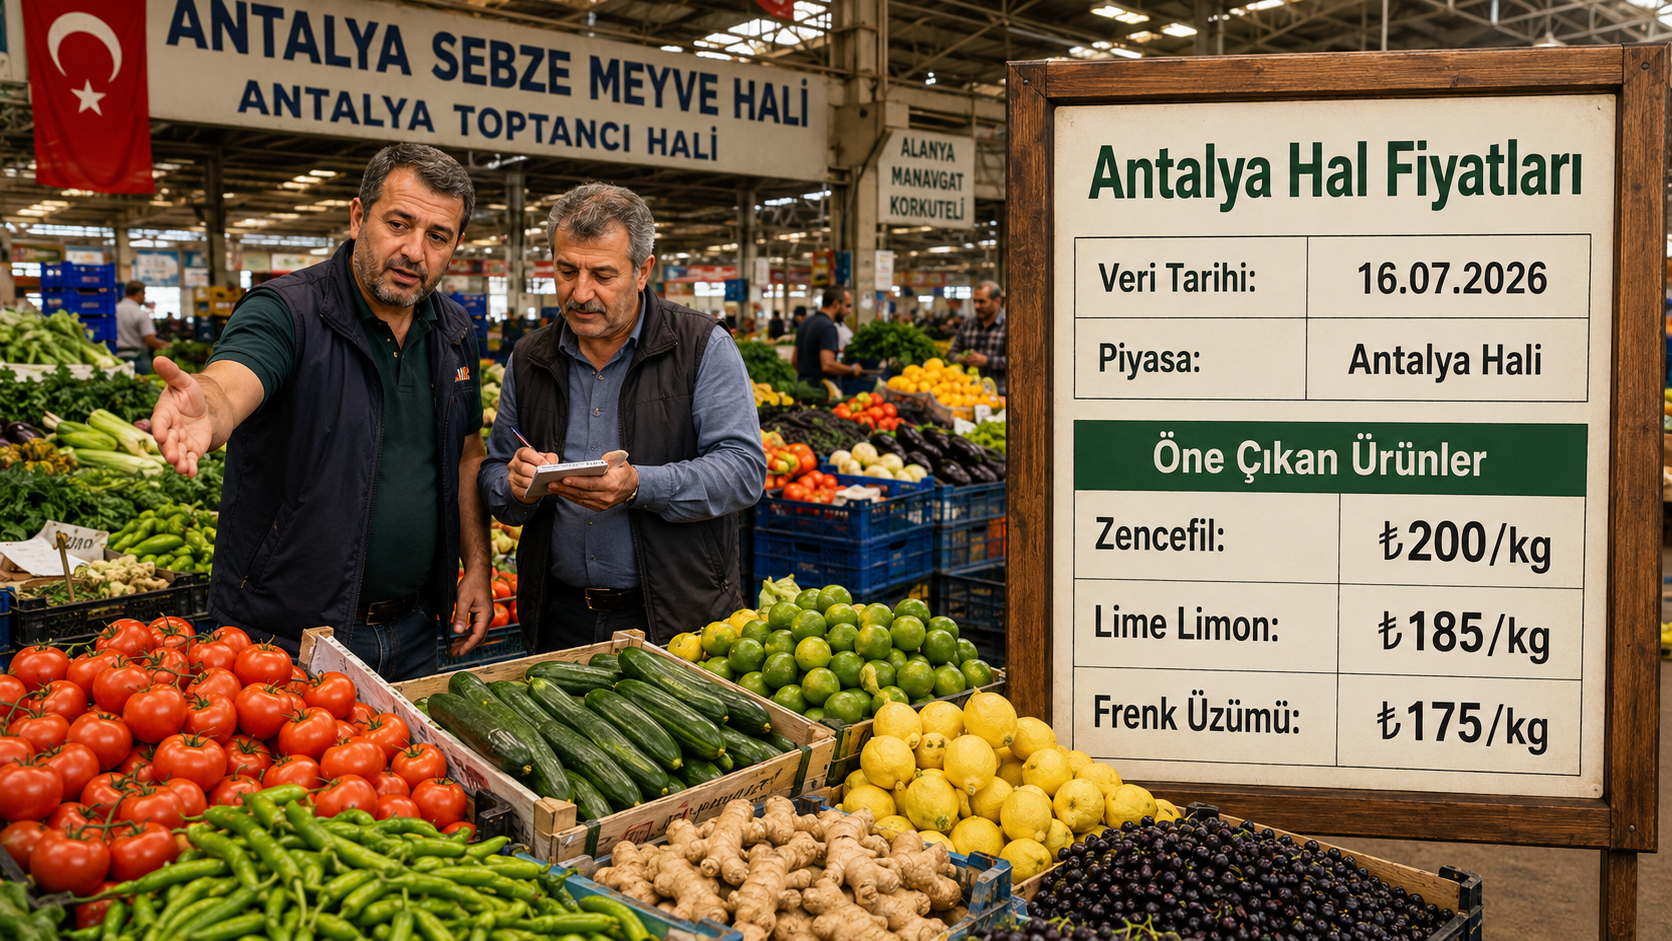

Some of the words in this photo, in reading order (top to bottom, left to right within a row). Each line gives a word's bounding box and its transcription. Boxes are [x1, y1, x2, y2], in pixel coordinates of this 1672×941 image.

[166, 0, 412, 76] ANTALYA
[432, 31, 571, 96] SEBZE
[590, 55, 718, 115] MEYVE
[734, 78, 807, 127] HALİ
[238, 80, 435, 133] ANTALYA
[453, 104, 630, 153] TOPTANCI
[648, 126, 717, 161] HALİ
[901, 137, 955, 162] ALANYA
[892, 166, 964, 191] MANAVGAT
[1089, 143, 1271, 212] Antalya
[1290, 141, 1367, 197] Hal
[1388, 139, 1581, 211] Fiyatları
[890, 196, 964, 220] KORKUTELİ
[1099, 262, 1155, 292] Veri
[1166, 262, 1255, 292] Tarihi:
[1359, 262, 1547, 294] 16.07.2026
[1100, 342, 1199, 380] Piyasa:
[1348, 343, 1470, 383] Antalya
[1483, 344, 1541, 375] Hali
[1154, 431, 1224, 473] Öne
[1237, 440, 1337, 483] Çıkan
[1353, 433, 1486, 476] Ürünler
[1096, 517, 1223, 551] Zencefil:
[1379, 520, 1550, 574] ₺200/kg
[1096, 605, 1166, 639] Lime
[1179, 607, 1278, 641] Limon:
[1378, 611, 1549, 664] ₺185/kg
[1095, 695, 1177, 730] Frenk
[1188, 690, 1299, 734] Üzümü:
[1377, 701, 1547, 755] ₺175/kg
